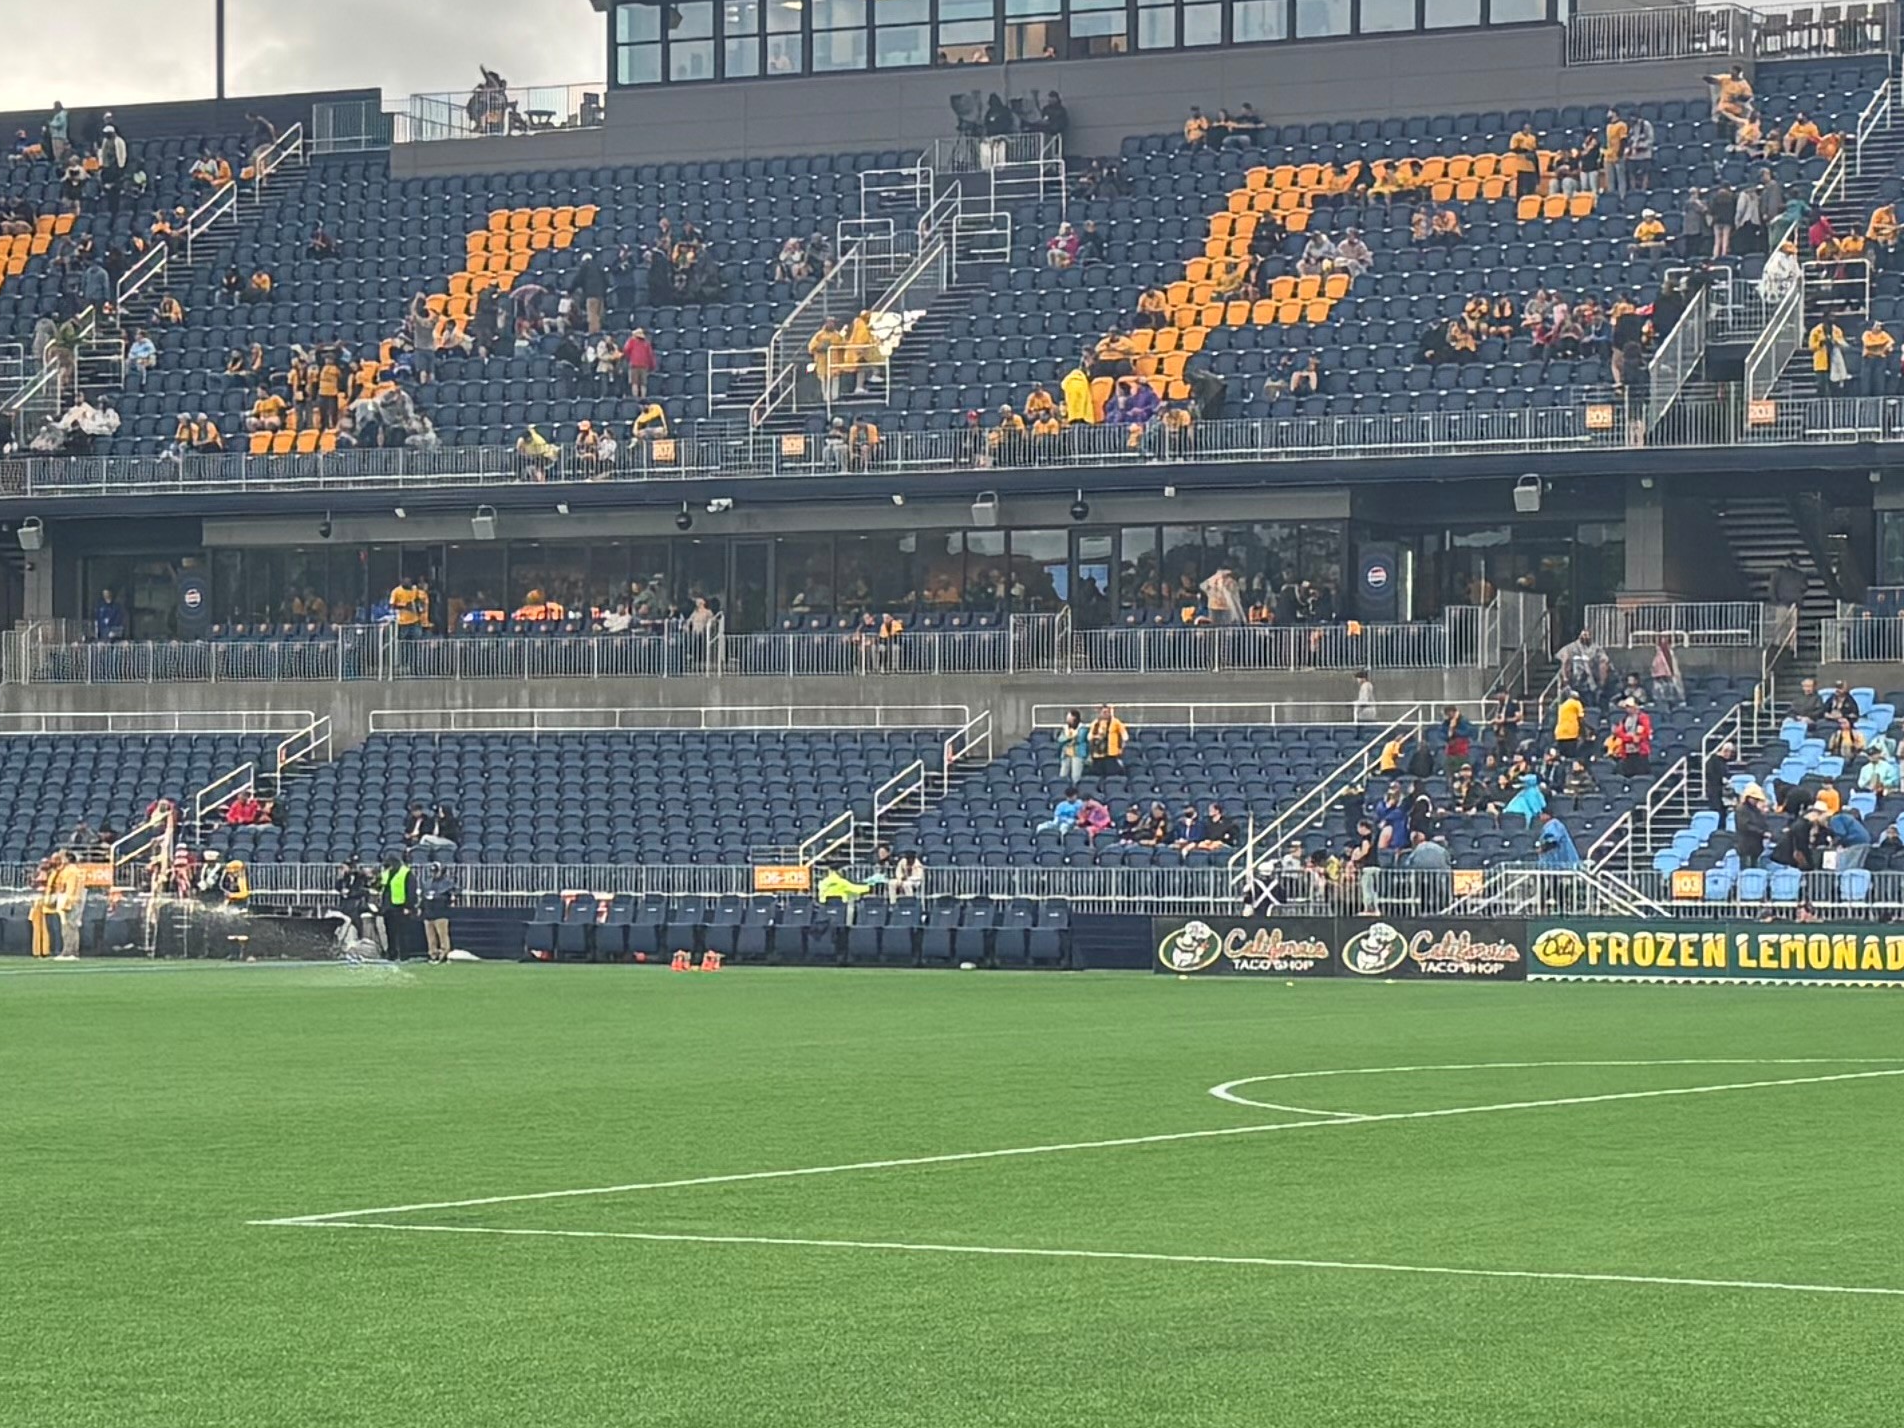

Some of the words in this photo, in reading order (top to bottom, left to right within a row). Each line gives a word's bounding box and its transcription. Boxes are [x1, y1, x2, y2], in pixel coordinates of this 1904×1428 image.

[1676, 879, 1701, 893] 103
[1223, 928, 1329, 960] California
[1409, 929, 1520, 962] California
[1586, 932, 1726, 968] FROZEN
[1233, 959, 1271, 970] TACO
[1272, 959, 1314, 971] SHOP
[1417, 961, 1458, 972] TACO
[1459, 962, 1505, 974] SHOP
